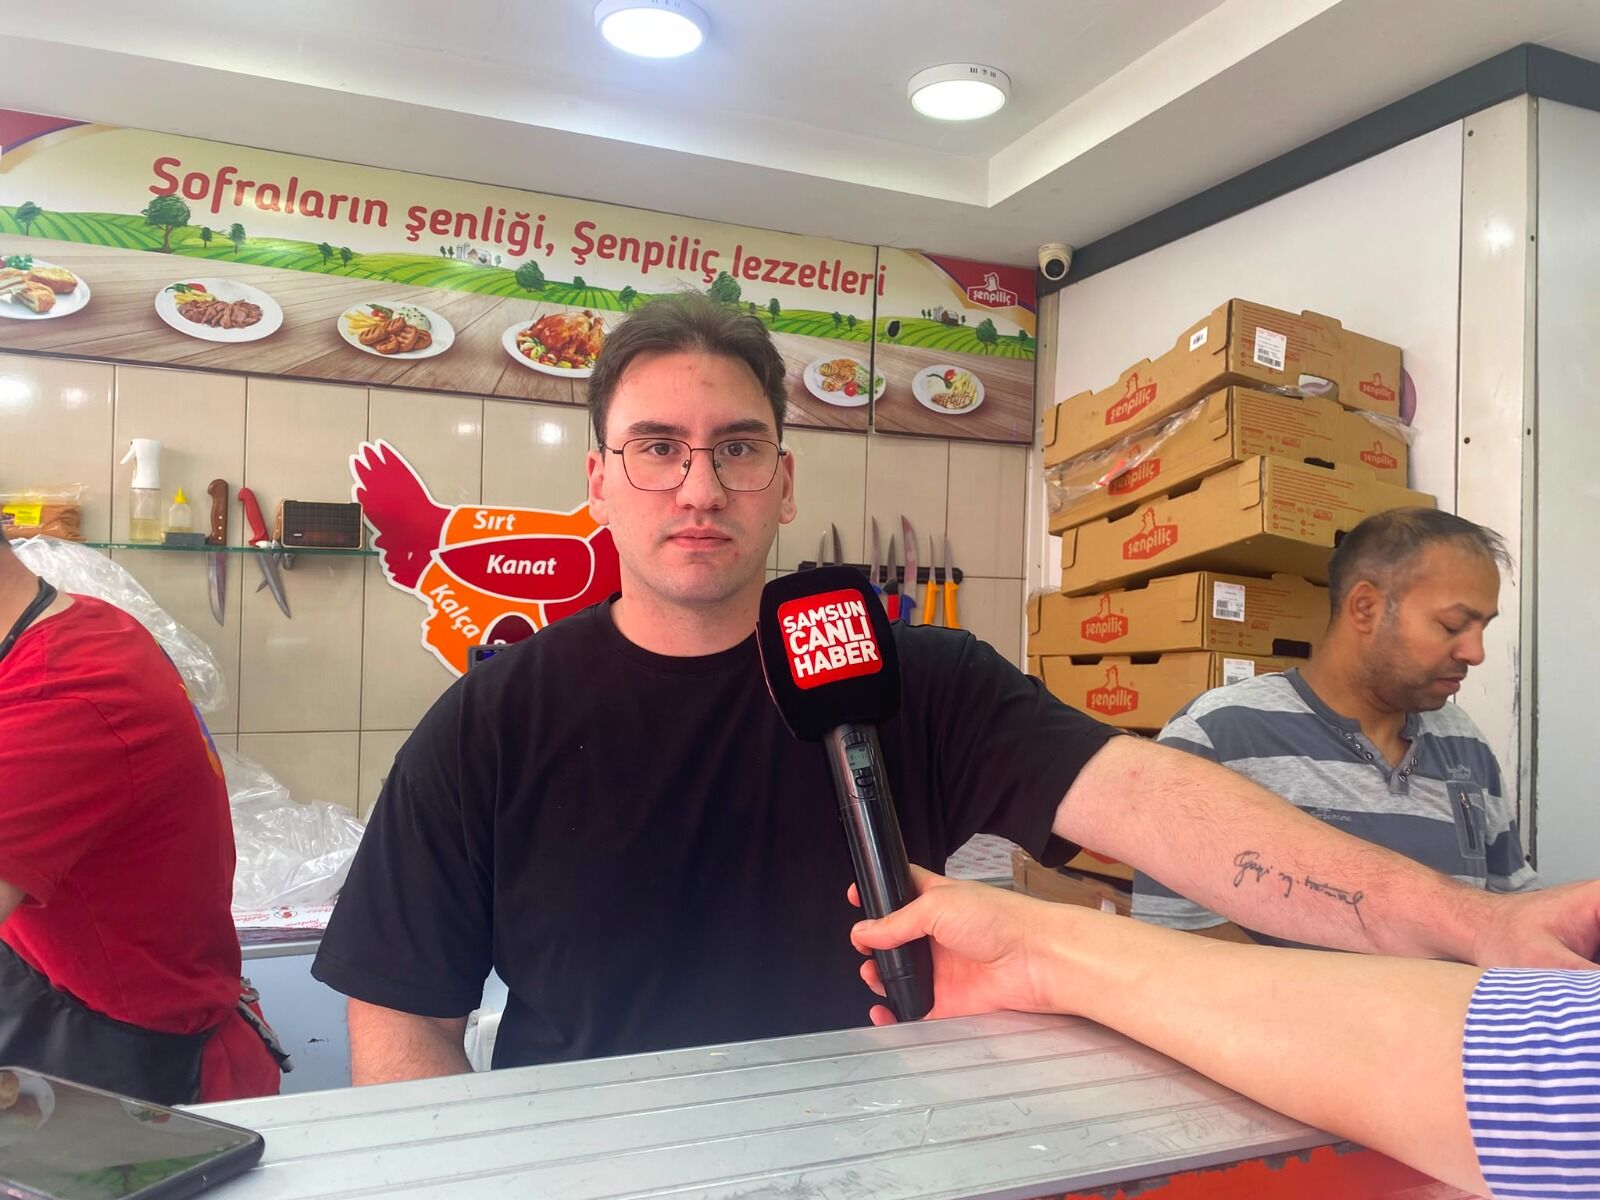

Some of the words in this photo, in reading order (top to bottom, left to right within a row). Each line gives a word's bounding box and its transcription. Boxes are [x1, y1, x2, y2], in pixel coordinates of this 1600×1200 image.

[149, 156, 388, 227] Sofraların
[405, 205, 554, 257] şenliği,
[571, 220, 719, 283] Şenpiliç
[732, 245, 886, 296] lezzetleri
[473, 510, 516, 531] Sırt
[486, 554, 557, 575] Kanat
[429, 583, 481, 639] Kalça
[783, 600, 866, 634] SAMSUN
[789, 616, 871, 655] CANLI
[793, 640, 878, 678] HABER
